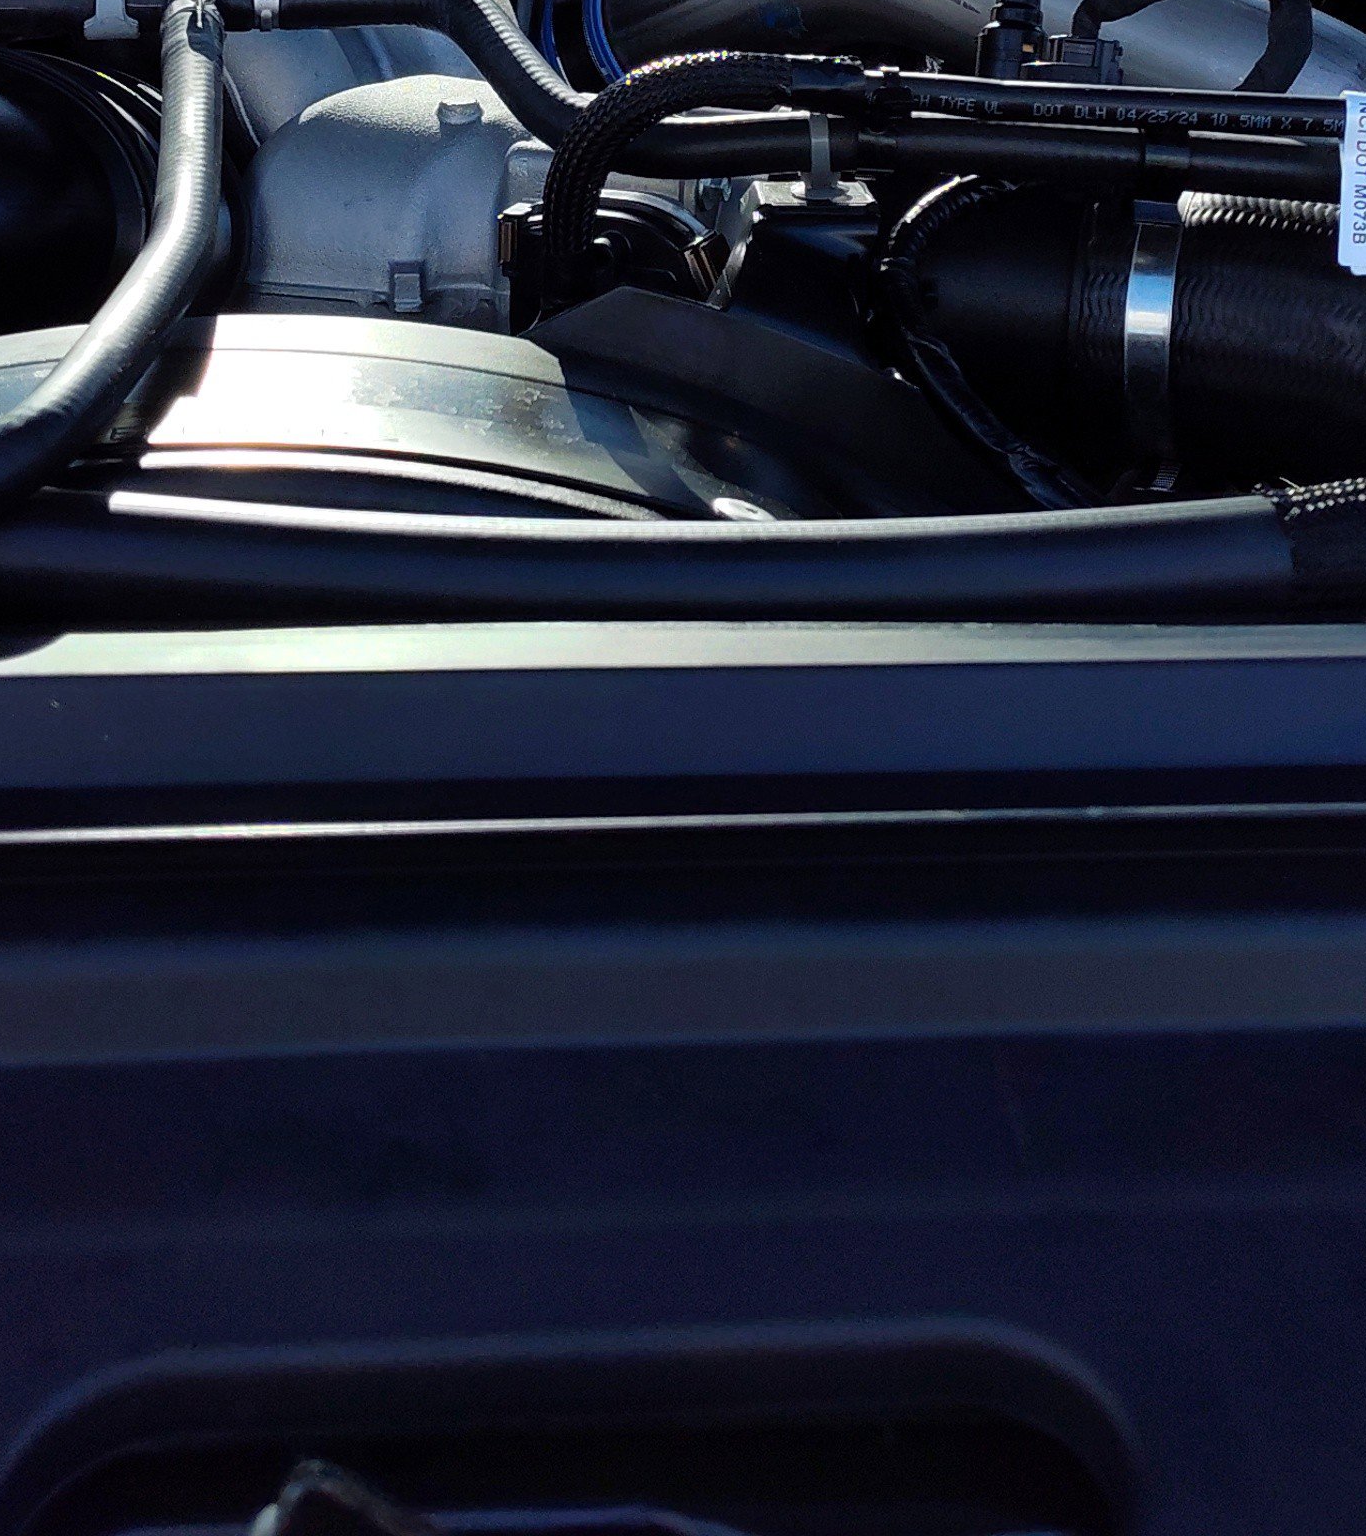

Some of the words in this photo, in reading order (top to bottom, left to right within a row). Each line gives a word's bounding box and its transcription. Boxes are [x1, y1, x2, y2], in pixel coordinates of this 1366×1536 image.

[938, 94, 977, 113] TYPE
[1032, 102, 1064, 118] DOT
[1073, 104, 1107, 120] DLH
[1116, 108, 1198, 126] 04/25/24
